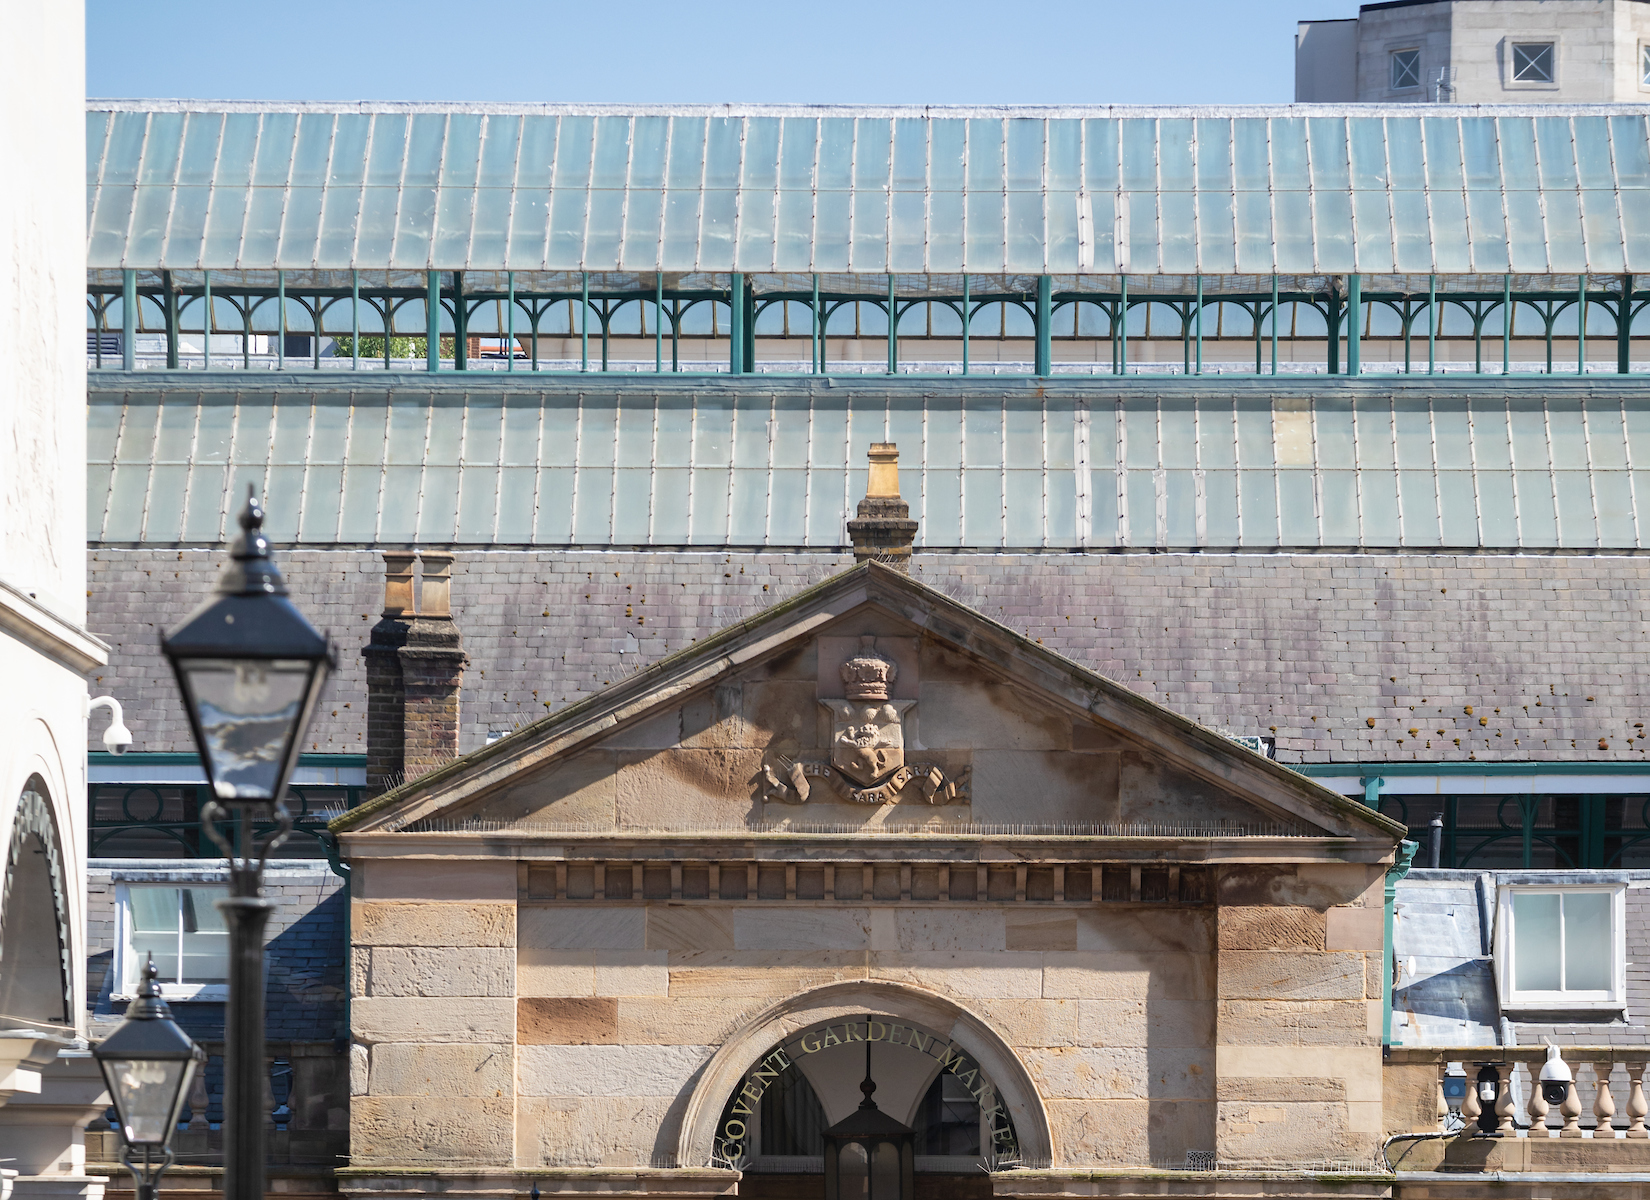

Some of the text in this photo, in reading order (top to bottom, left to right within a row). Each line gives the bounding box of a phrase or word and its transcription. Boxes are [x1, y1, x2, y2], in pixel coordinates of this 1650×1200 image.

[803, 764, 830, 778] CHE
[897, 765, 930, 784] SARA
[721, 1047, 791, 1161] COVENT
[801, 1021, 931, 1054] GARDEN
